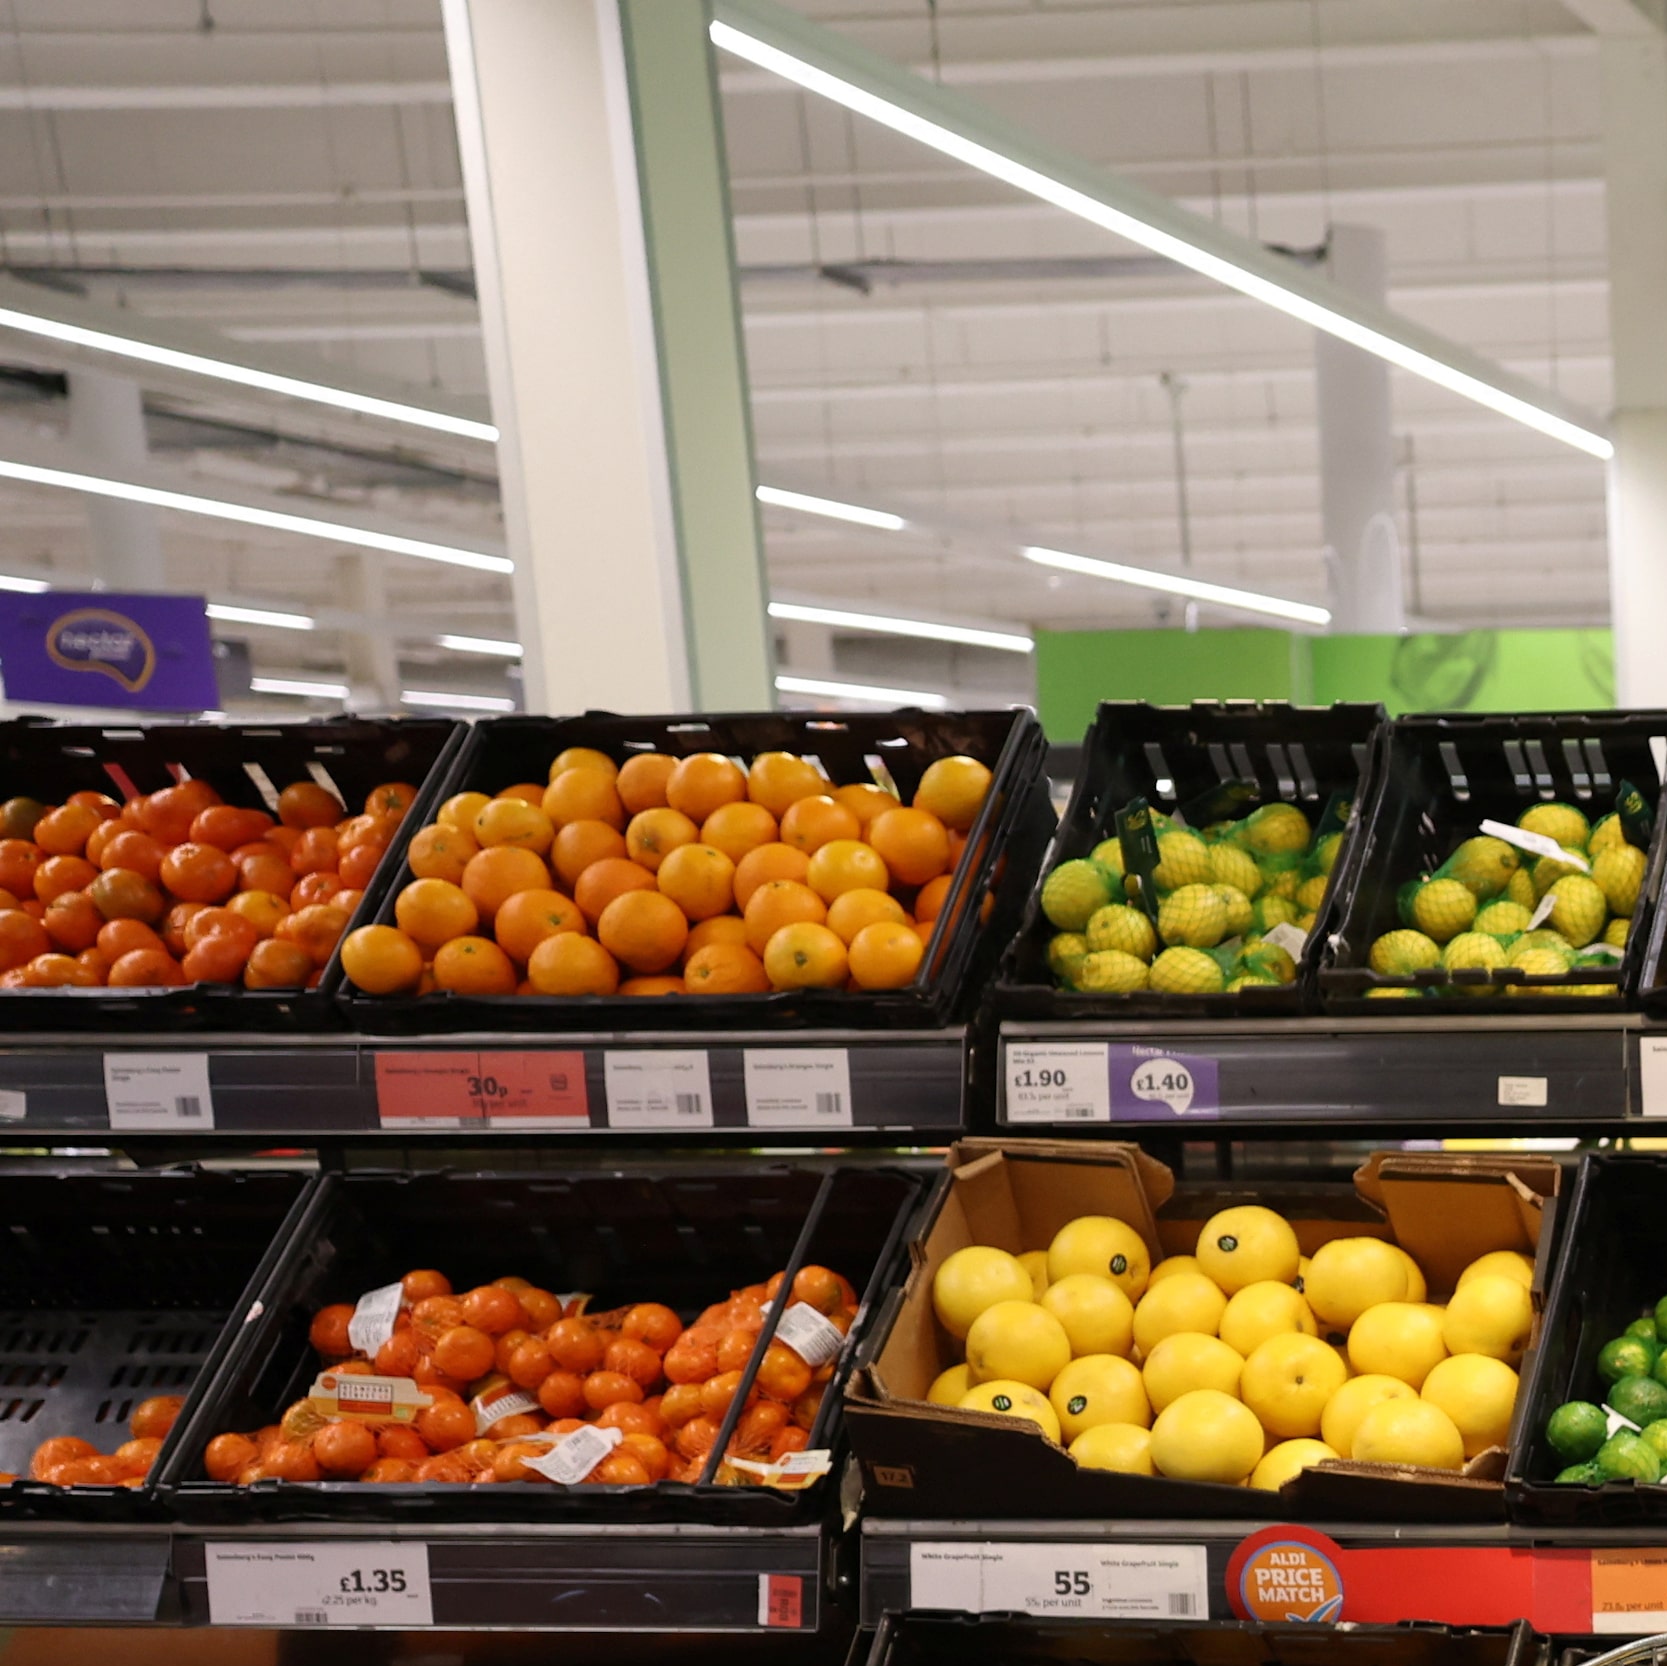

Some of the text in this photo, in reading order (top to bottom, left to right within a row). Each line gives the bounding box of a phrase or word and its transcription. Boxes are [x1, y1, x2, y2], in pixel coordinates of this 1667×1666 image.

[467, 1076, 507, 1097] 30p
[1015, 1069, 1066, 1088] £1.90
[1137, 1073, 1188, 1091] £1.40
[922, 1552, 1003, 1561] White Grapefruit Single
[1101, 1559, 1179, 1568] White Grapefruit Single
[1270, 1552, 1307, 1566] ALDI
[340, 1569, 407, 1593] £1.35
[1255, 1567, 1324, 1586] PRICE
[1043, 1599, 1060, 1608] per
[1062, 1598, 1081, 1607] unit
[1258, 1587, 1325, 1603] MATCH
[1626, 1602, 1642, 1612] per
[1644, 1600, 1664, 1610] unit
